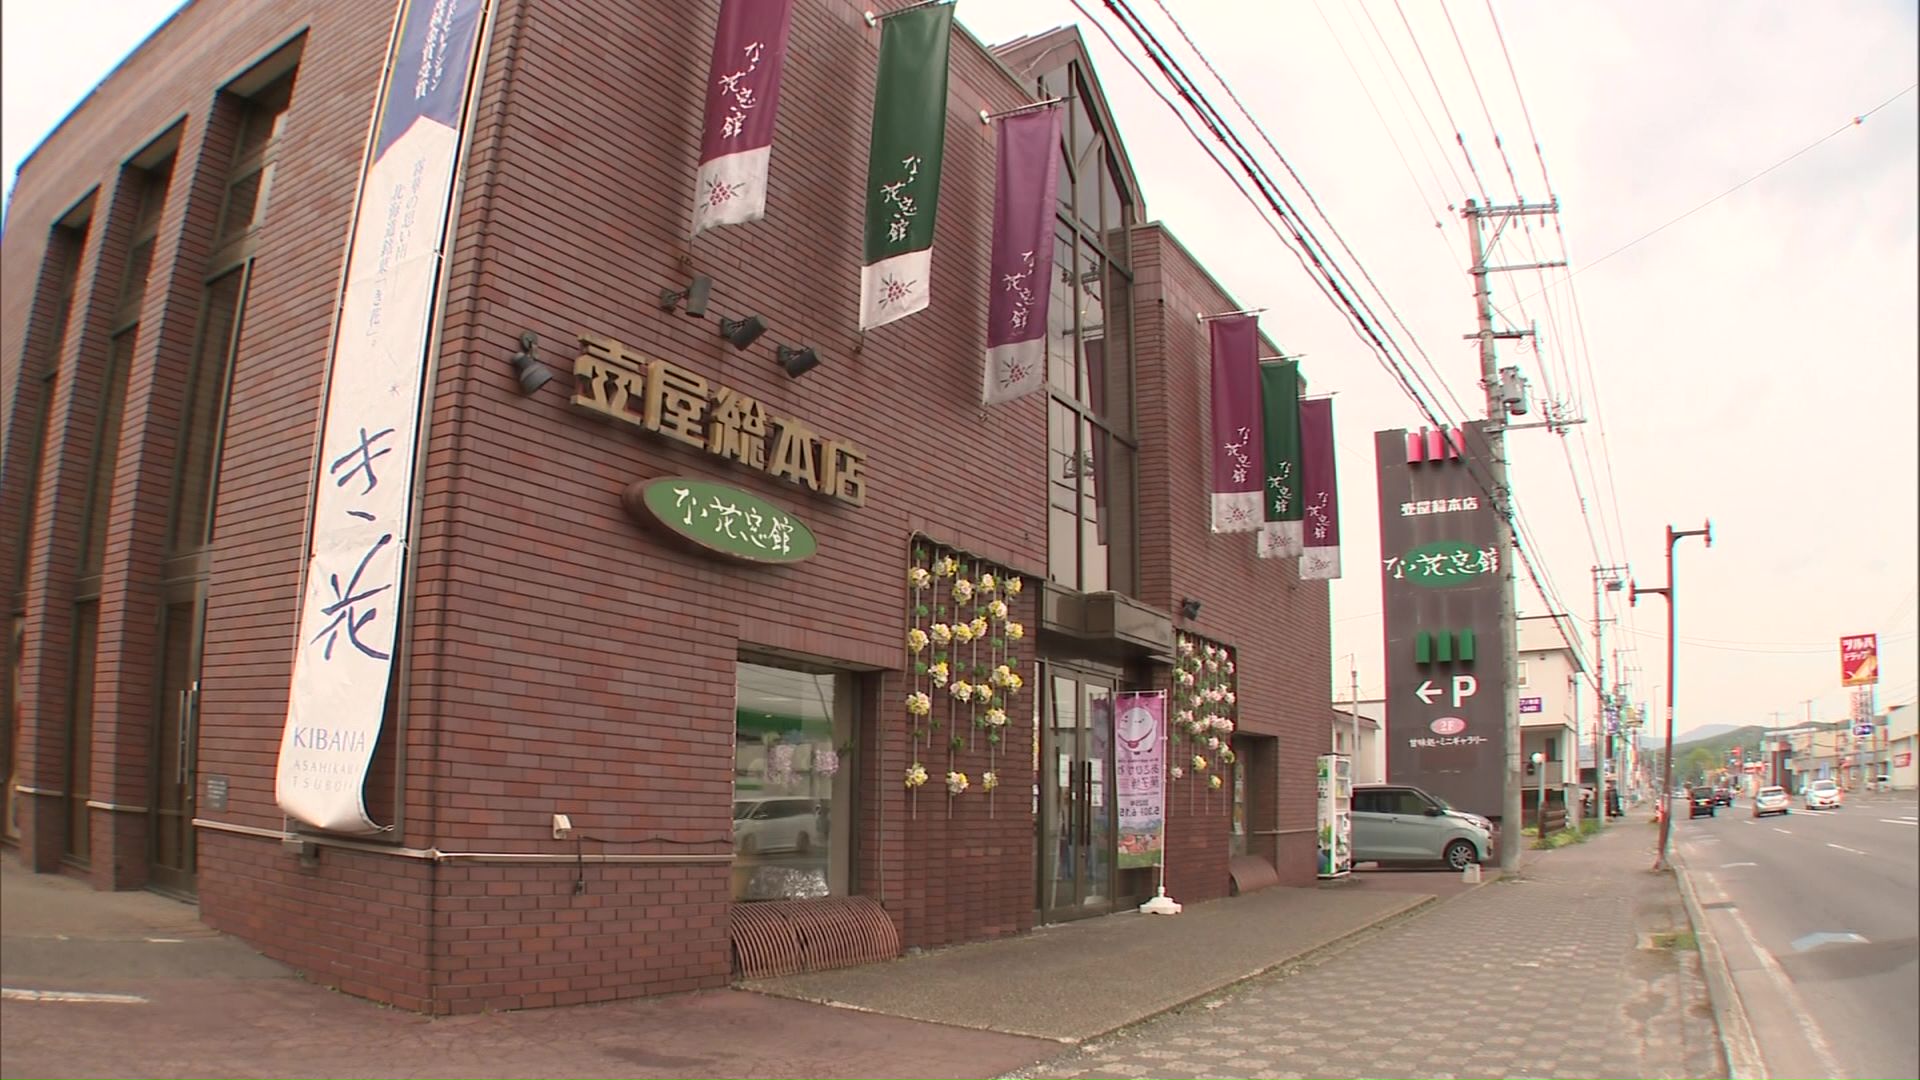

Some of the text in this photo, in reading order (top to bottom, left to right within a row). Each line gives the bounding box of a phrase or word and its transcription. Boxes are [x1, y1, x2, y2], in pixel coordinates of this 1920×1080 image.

[1452, 675, 1477, 708] P
[293, 726, 365, 752] KIBANA
[1440, 721, 1455, 732] 2F
